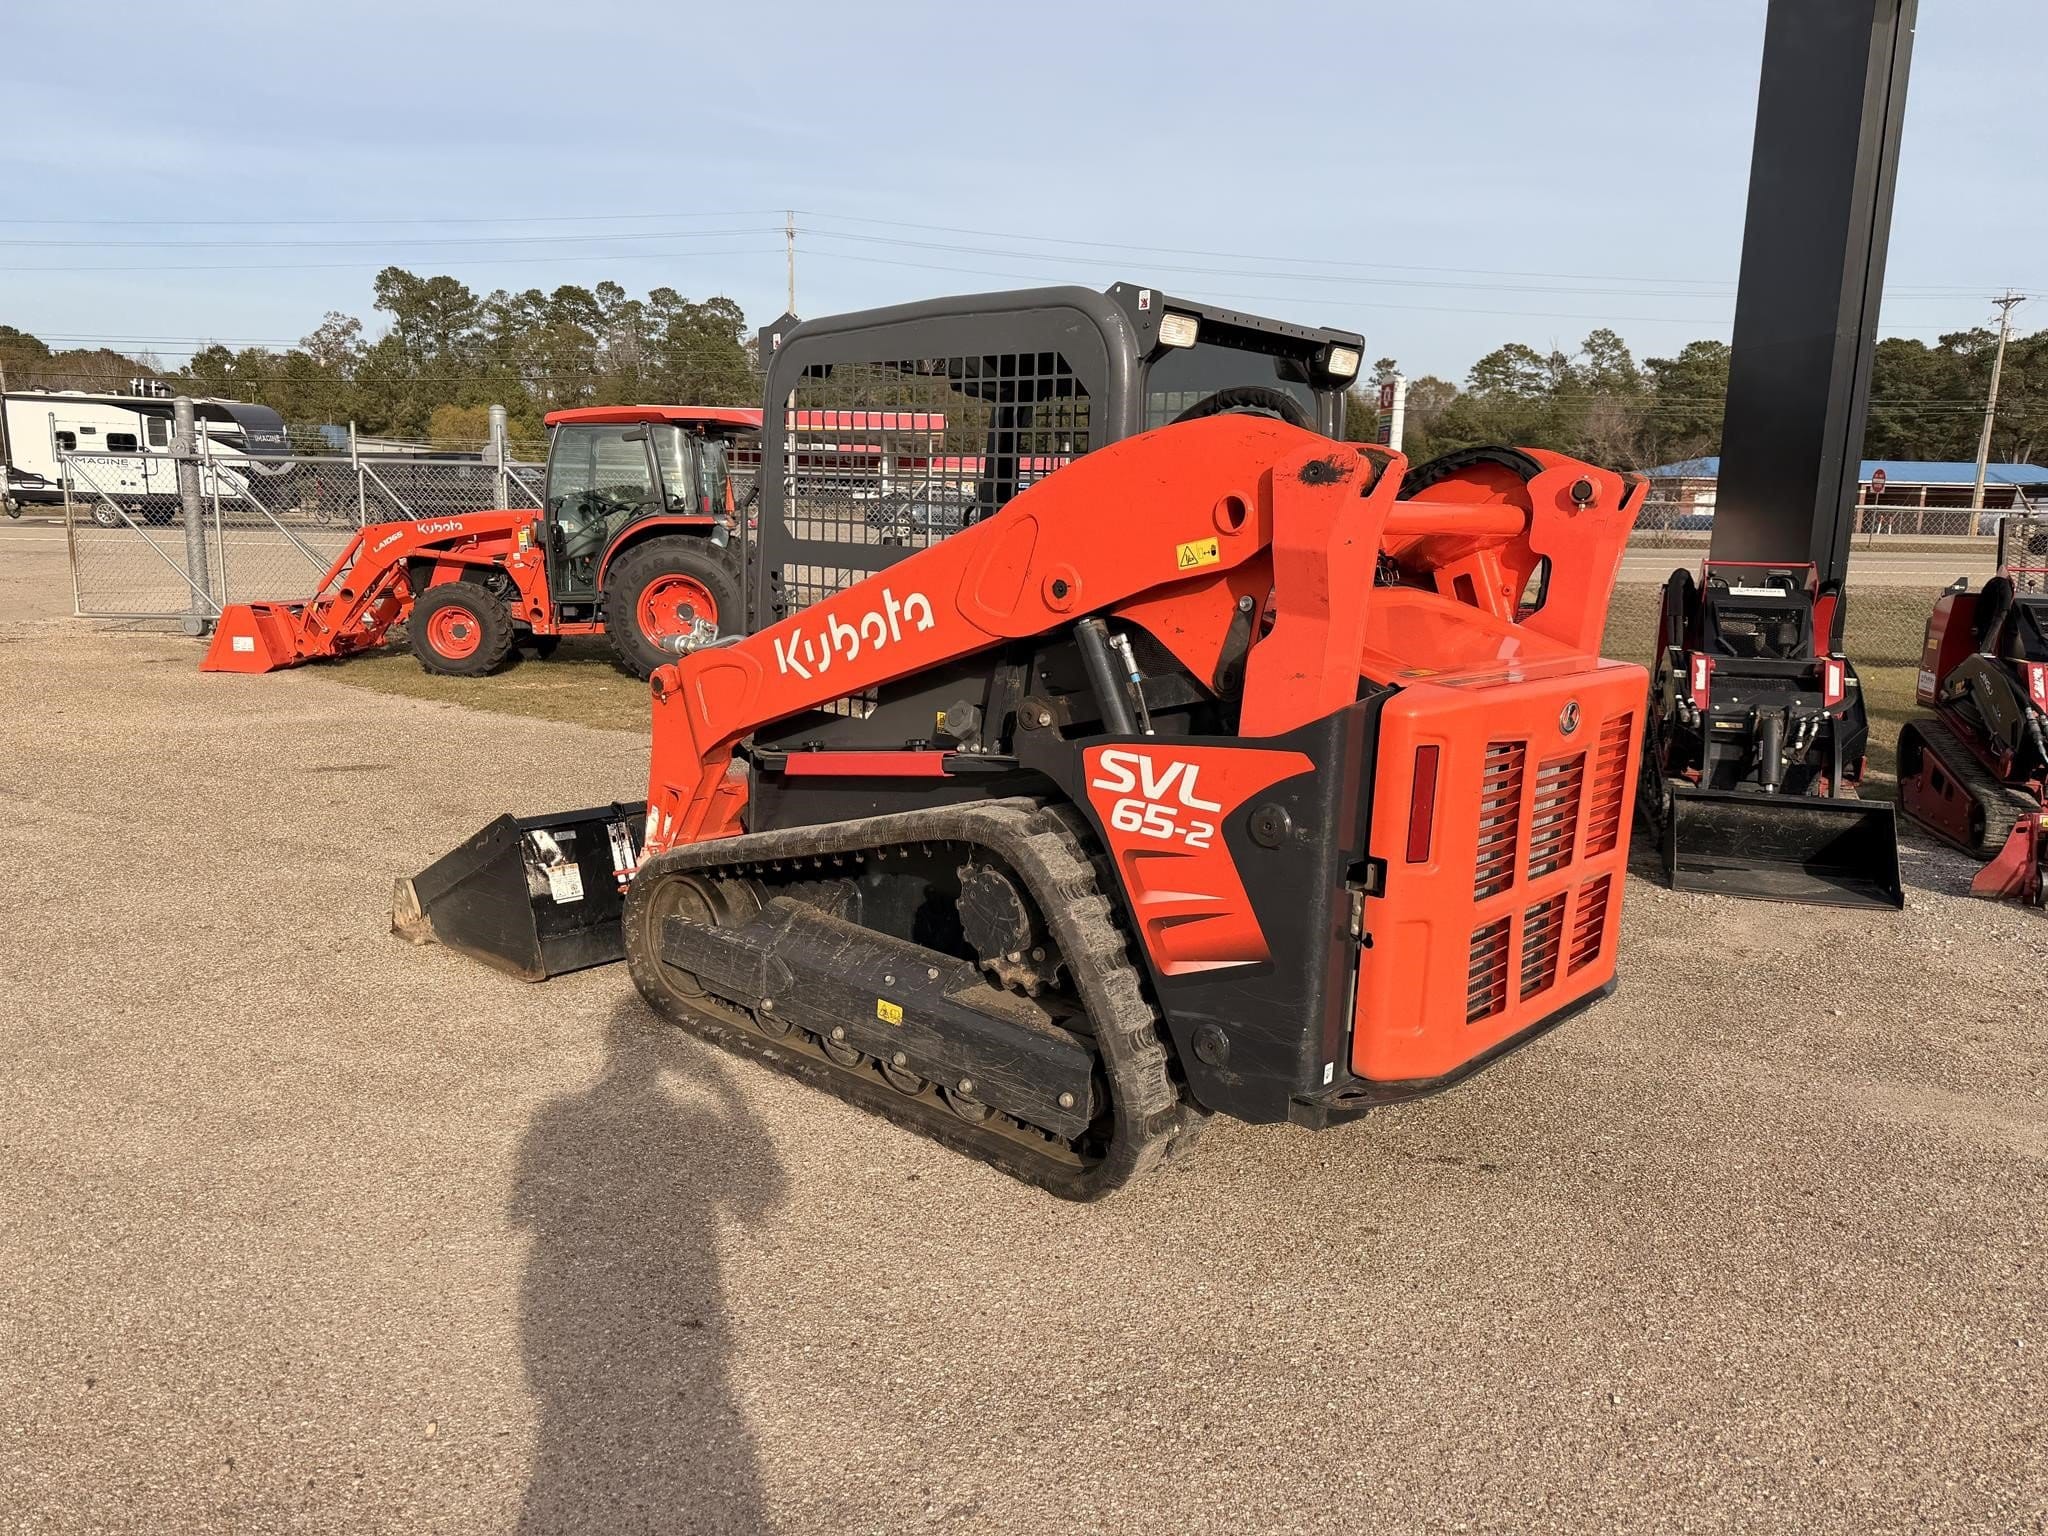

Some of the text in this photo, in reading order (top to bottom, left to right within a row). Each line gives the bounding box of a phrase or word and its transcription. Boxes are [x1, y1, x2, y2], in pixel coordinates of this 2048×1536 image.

[417, 520, 463, 534] Kubota
[773, 587, 936, 680] Kubota
[1092, 749, 1222, 813] SVL
[1110, 798, 1215, 849] 65-2
